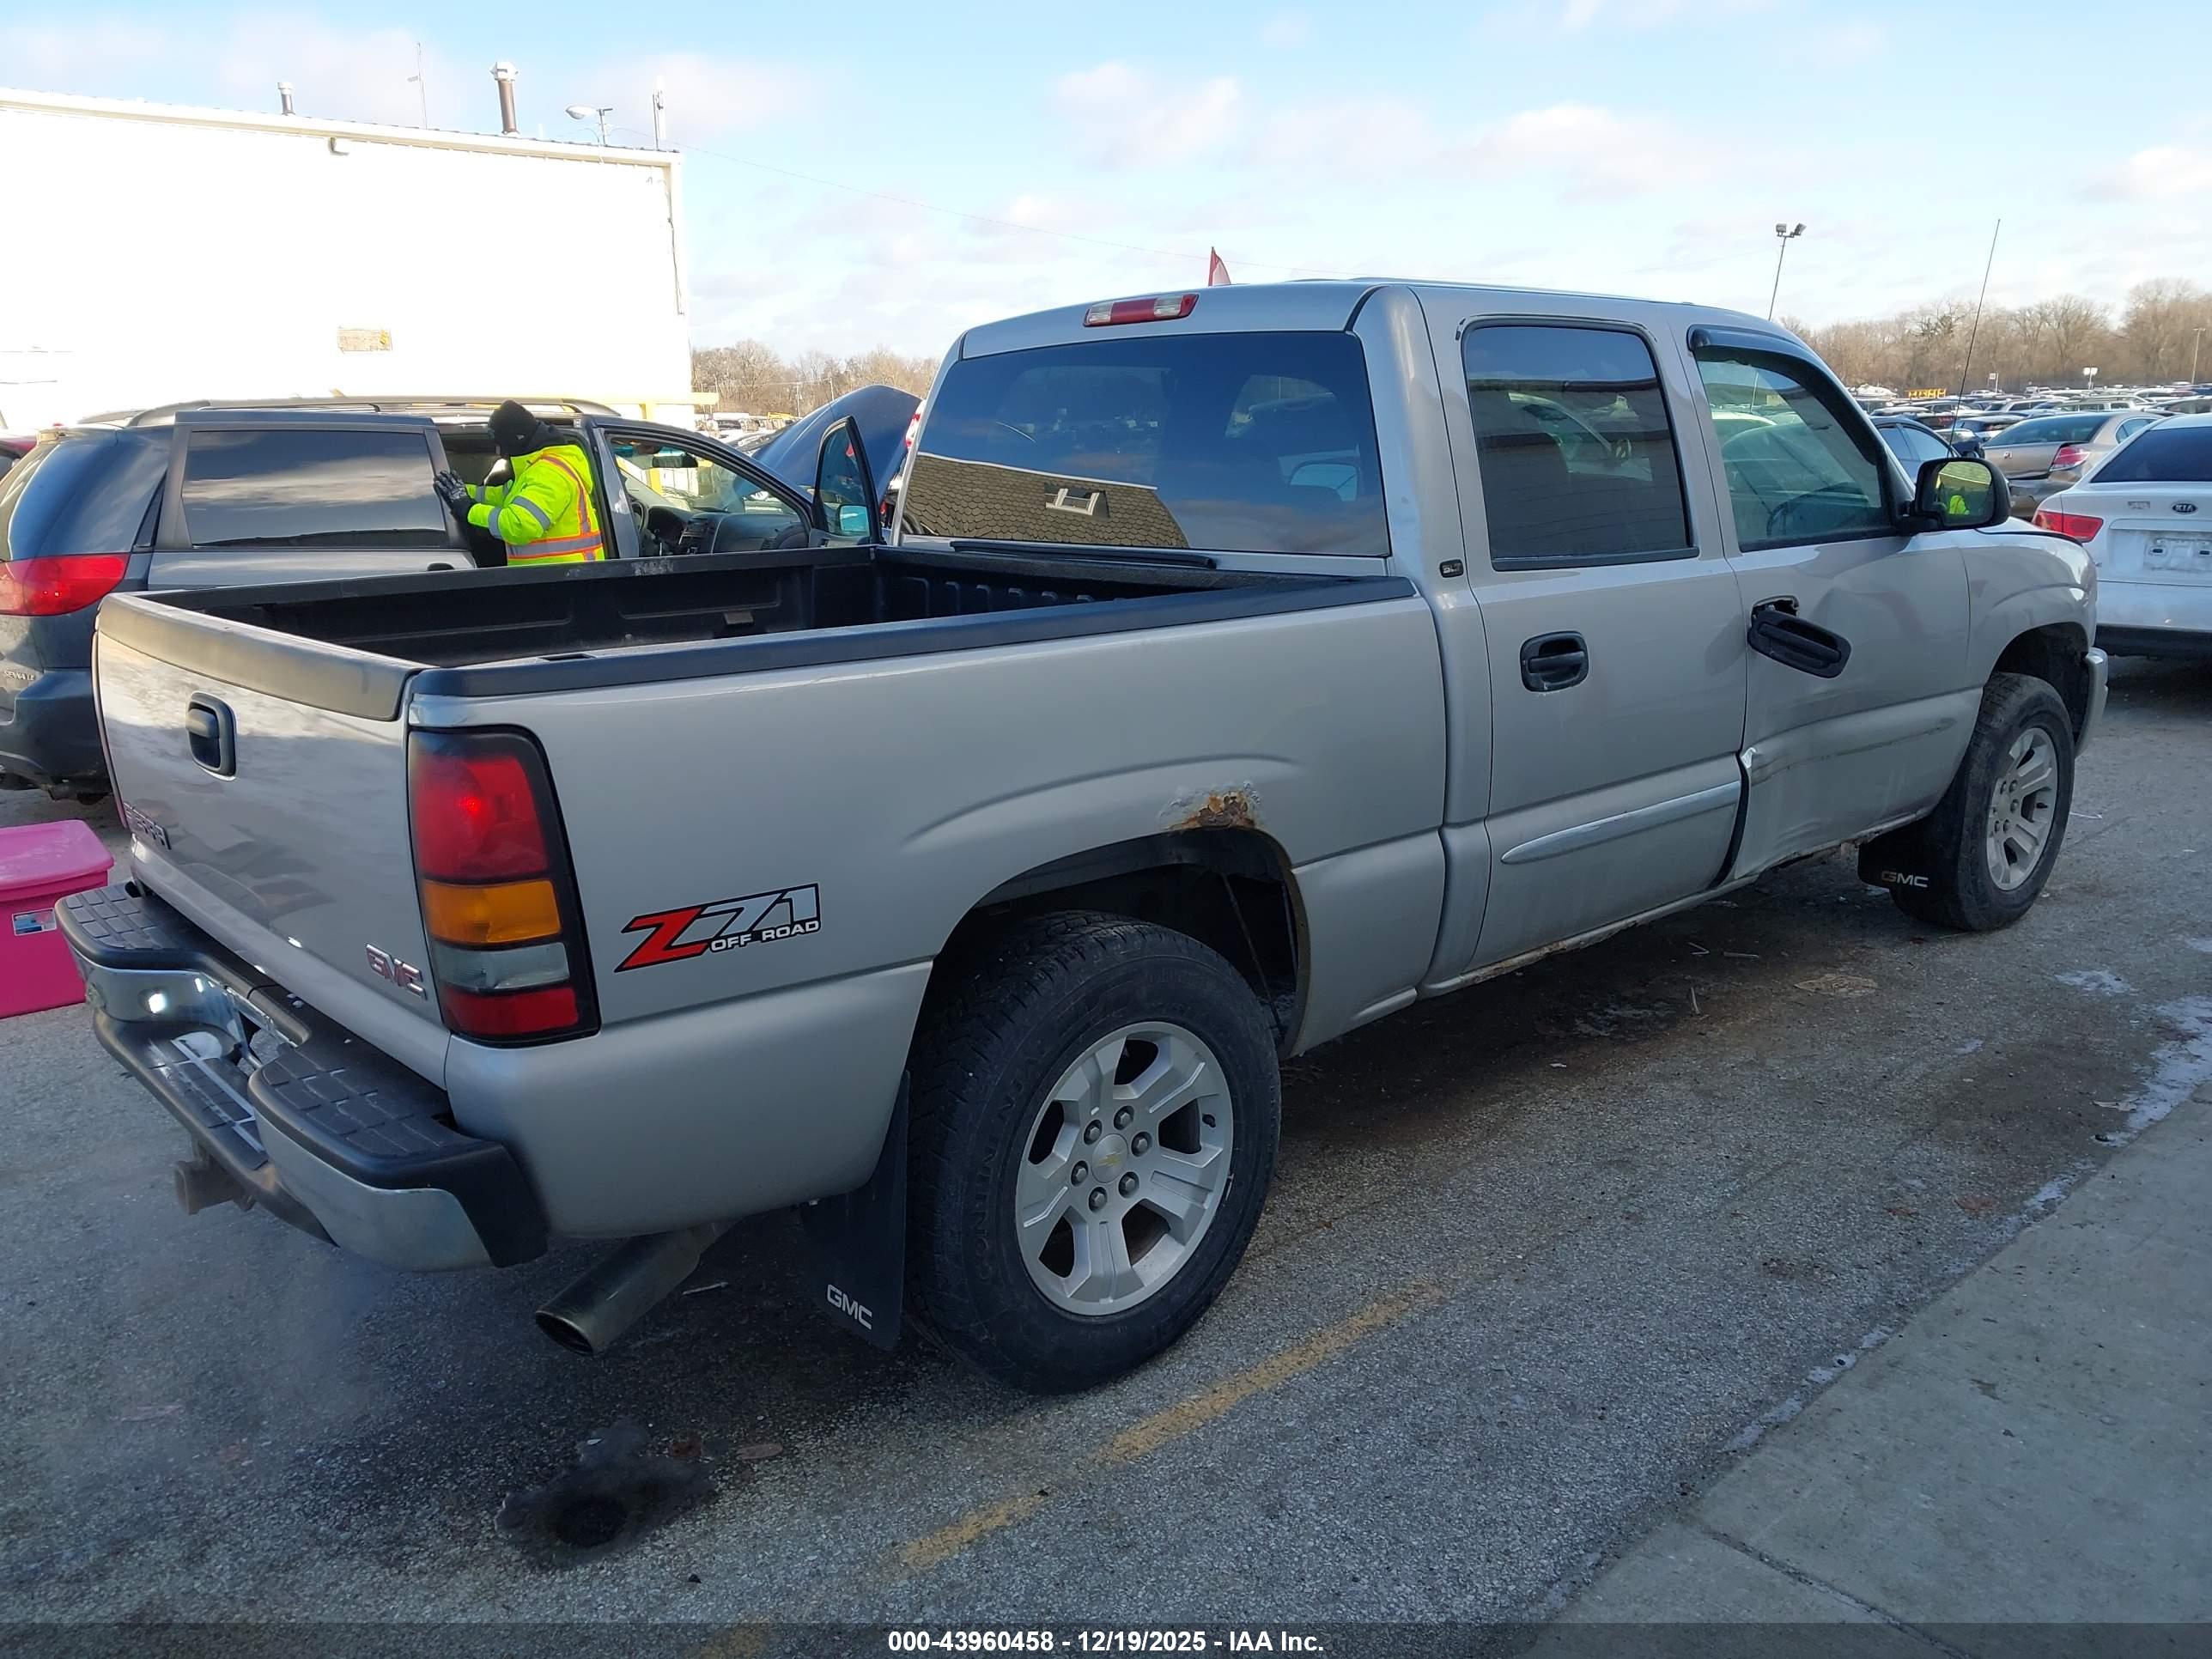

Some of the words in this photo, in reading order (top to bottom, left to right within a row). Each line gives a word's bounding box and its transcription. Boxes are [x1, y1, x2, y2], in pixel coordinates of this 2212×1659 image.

[1881, 871, 1929, 888] GMC
[613, 883, 821, 973] Z71
[710, 933, 752, 952] OFF
[761, 920, 820, 942] ROAD
[827, 1284, 872, 1330] GMC
